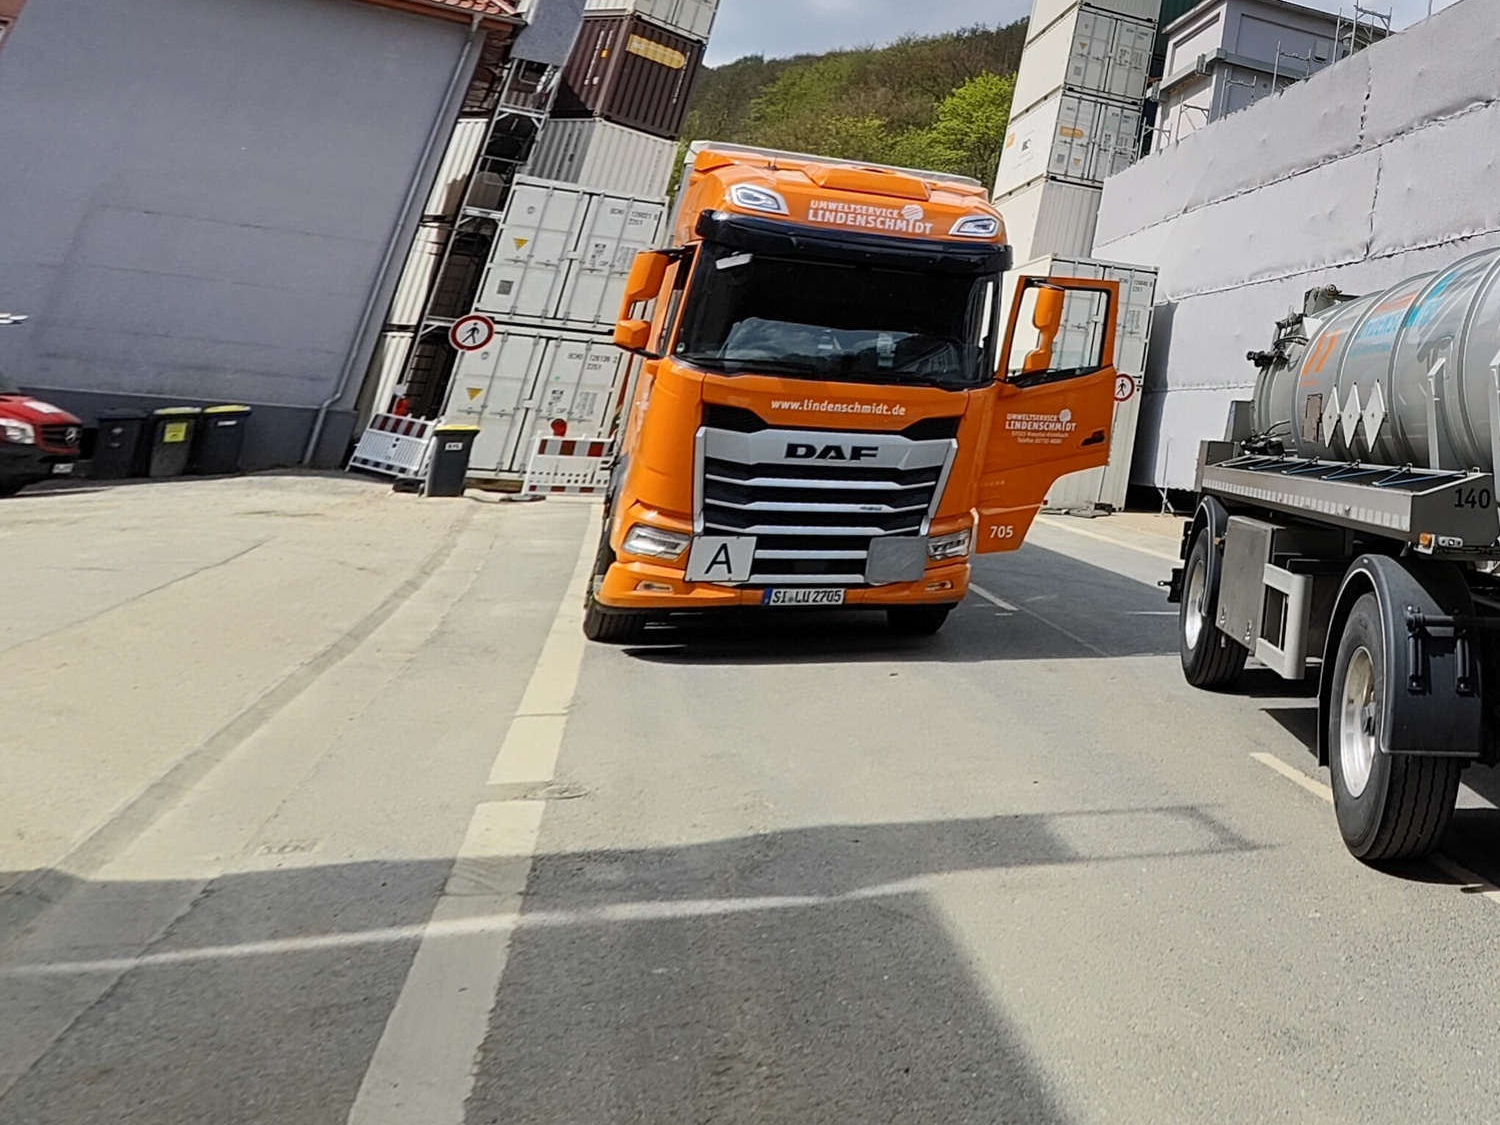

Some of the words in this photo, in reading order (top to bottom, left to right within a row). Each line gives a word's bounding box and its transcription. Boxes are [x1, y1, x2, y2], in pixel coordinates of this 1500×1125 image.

[810, 200, 899, 218] UMWELTSERVICE
[807, 209, 933, 235] LINDENSCHMIDT
[771, 399, 907, 416] www.lindenschmidt.de
[1005, 421, 1077, 432] LINDENSCHMIDT
[1006, 413, 1058, 422] UMWELTSERVICE
[784, 442, 879, 461] DAF
[1454, 487, 1491, 509] 140
[990, 525, 1014, 539] 705
[704, 542, 733, 575] A
